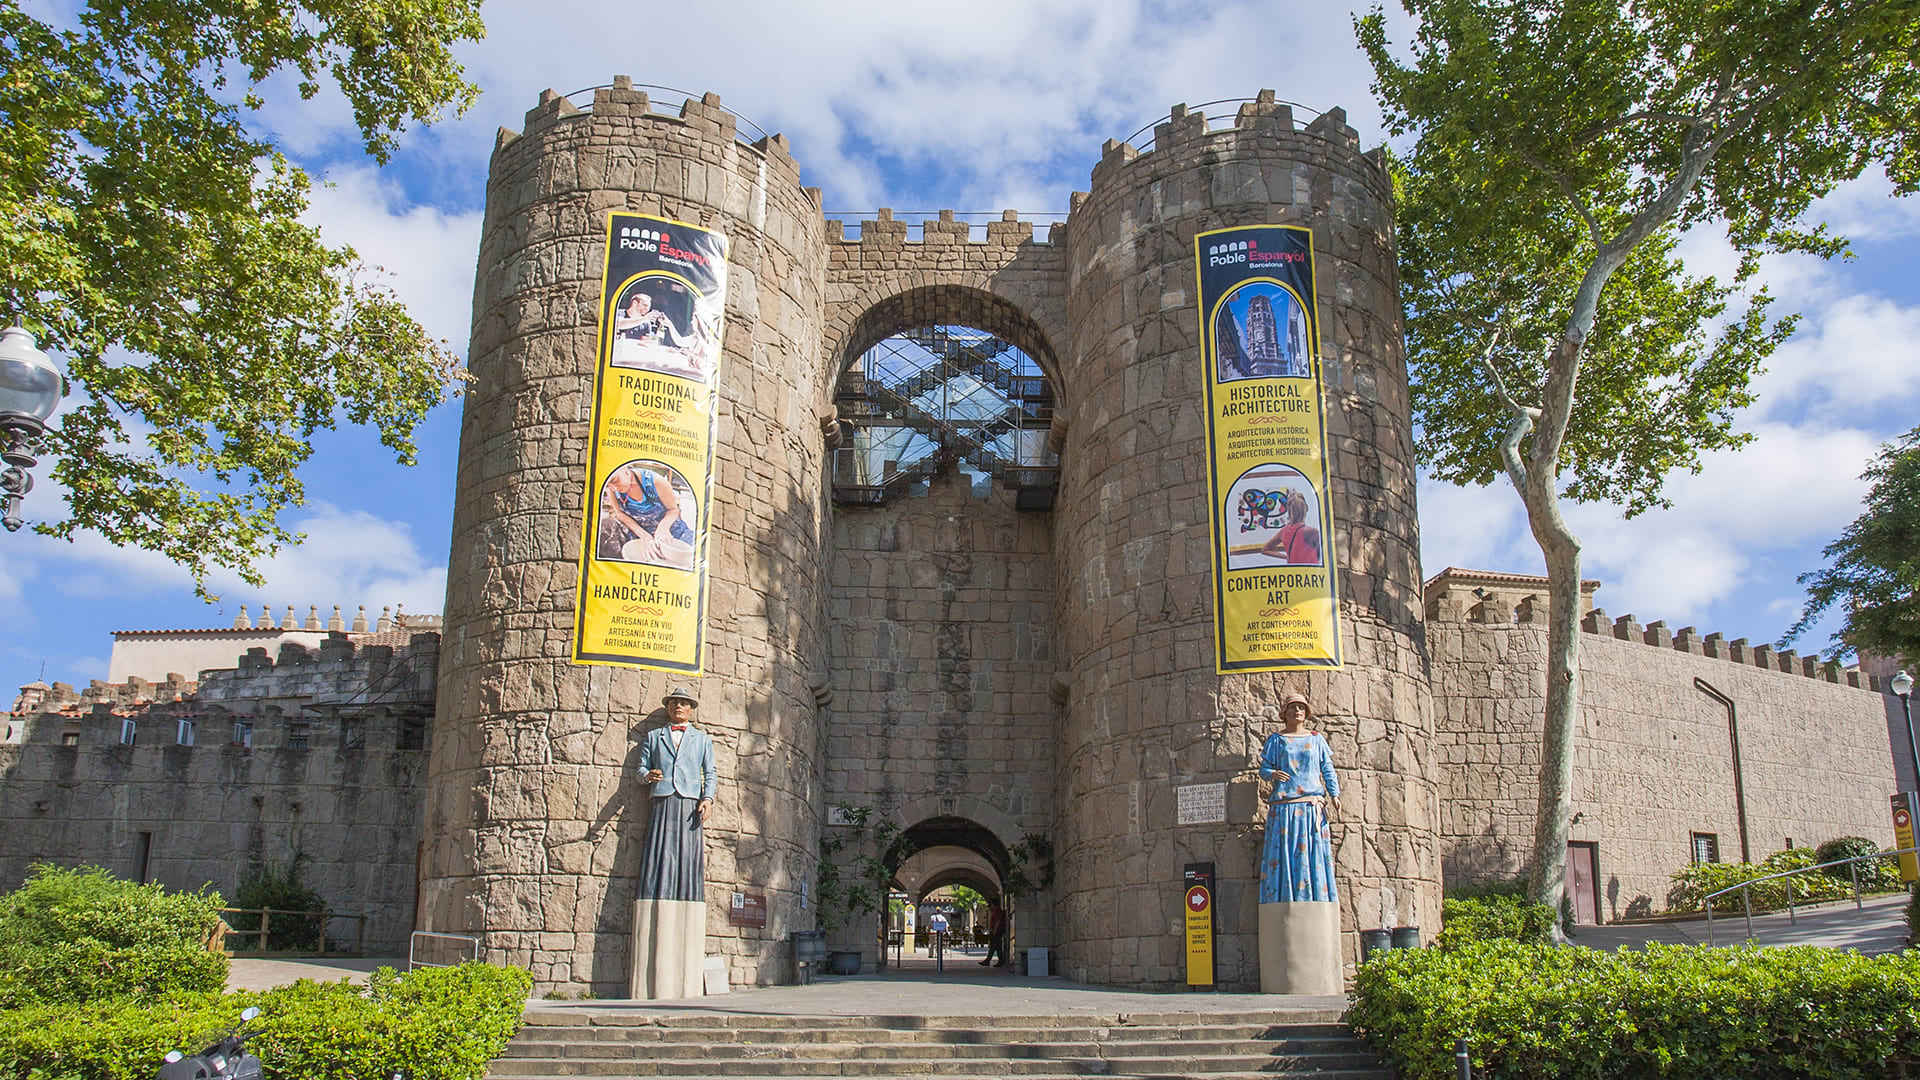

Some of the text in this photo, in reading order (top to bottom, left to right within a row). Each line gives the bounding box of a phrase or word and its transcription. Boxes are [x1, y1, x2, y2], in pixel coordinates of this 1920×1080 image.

[620, 238, 712, 266] Poble Espany
[1210, 250, 1305, 267] Poble Espanyol
[658, 255, 693, 268] Barcelona
[619, 375, 697, 402] TRADITIONAL
[1230, 384, 1301, 401] HISTORICAL
[633, 393, 683, 413] CUISINE
[1222, 400, 1311, 417] ARCHITECTURE
[658, 424, 700, 440] TRADICIONAL
[1228, 428, 1274, 439] ARQUITECTURA
[602, 438, 704, 462] GASTRONOMIE TRADITIONNELLE
[658, 435, 698, 451] TRADICIONAL
[1228, 438, 1276, 450] ARQUITECTURA
[1227, 448, 1312, 460] ARCHITECTURE HISTORIQUE
[631, 571, 659, 588] LIVE
[1227, 574, 1325, 592] CONTEMPORARY
[594, 584, 692, 609] HANDCRAFTING
[1267, 590, 1290, 605] ART
[650, 620, 660, 628] EN
[661, 620, 673, 630] VIU
[1247, 620, 1312, 630] ART CONTEMPORANI
[648, 631, 656, 640] EN
[658, 633, 674, 642] VIVO
[1242, 630, 1318, 642] ARTE CONTEMPORÁNEO
[604, 638, 676, 654] ARTISANAT EN DIRECT
[1248, 642, 1314, 653] ART CONTEMPORAIN
